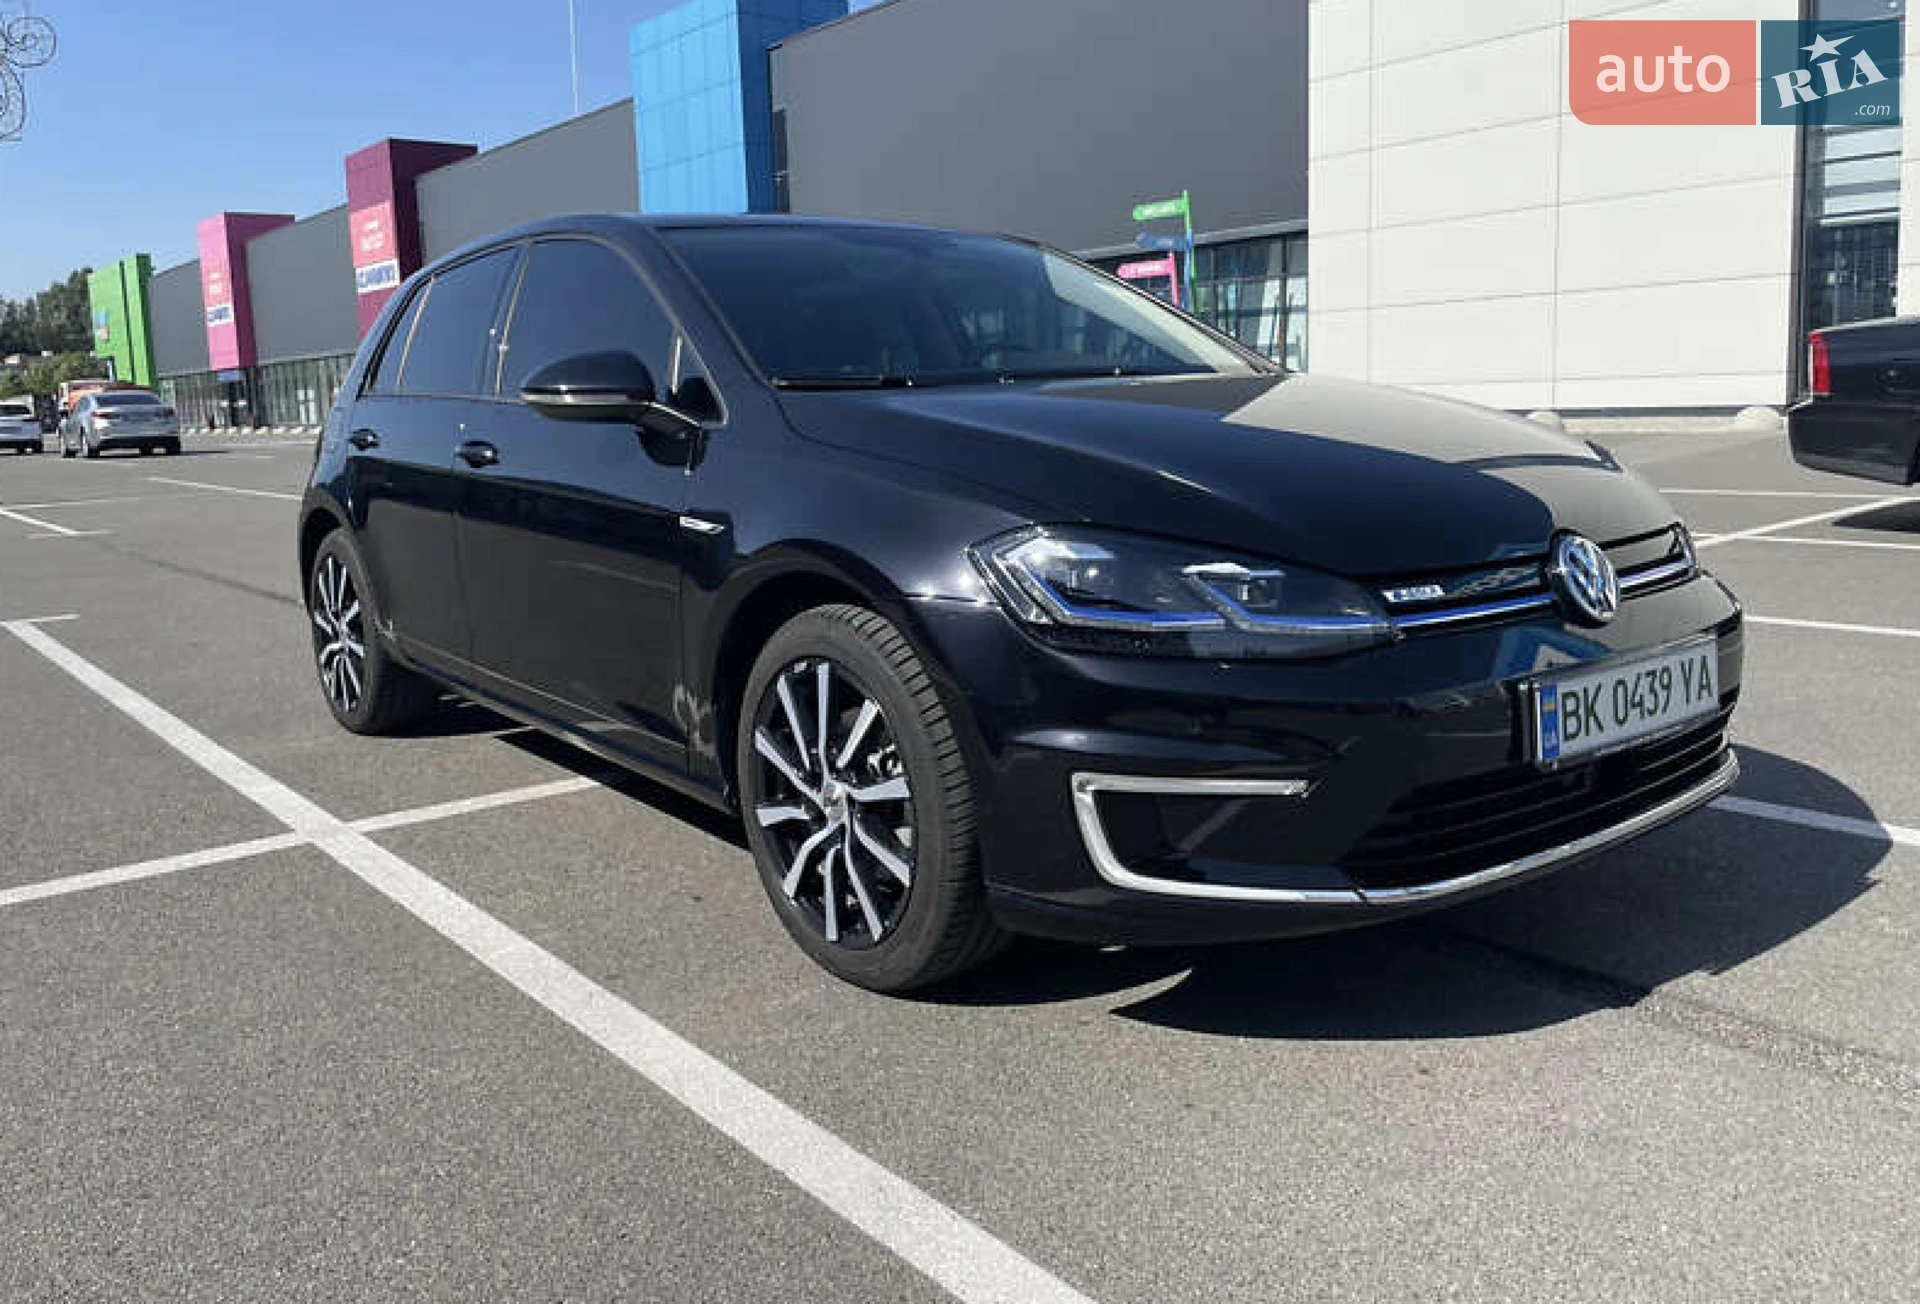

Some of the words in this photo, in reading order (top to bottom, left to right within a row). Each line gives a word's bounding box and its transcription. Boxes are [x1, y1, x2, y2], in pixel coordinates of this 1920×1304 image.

[1561, 682, 1604, 742] BK
[1612, 665, 1673, 726] 0439
[1680, 655, 1713, 707] YA
